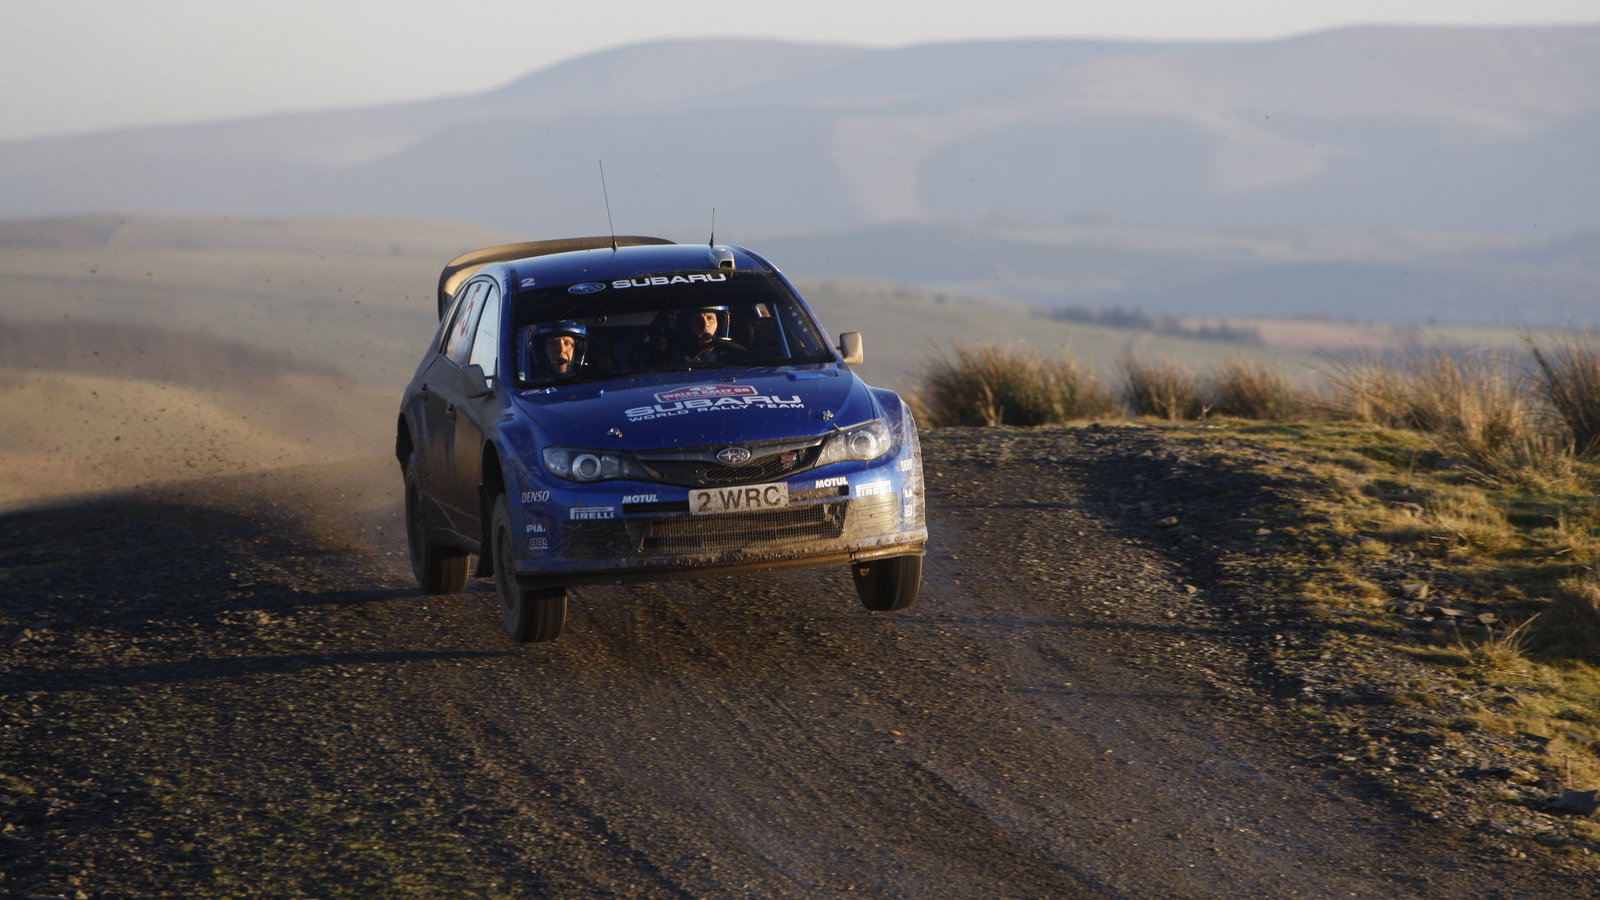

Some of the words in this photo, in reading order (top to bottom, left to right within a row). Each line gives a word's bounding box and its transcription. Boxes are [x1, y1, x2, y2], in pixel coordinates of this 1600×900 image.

[520, 277, 535, 288] 2
[611, 273, 727, 289] SUBARU
[701, 387, 732, 395] RALLY
[624, 395, 802, 418] SUBARU
[629, 409, 689, 422] WORLD
[697, 404, 748, 412] RALLY
[815, 476, 848, 489] MOTUL
[521, 490, 550, 504] DENSO
[622, 494, 658, 504] MOTUL
[697, 491, 712, 513] 2
[719, 485, 781, 511] WRC
[569, 506, 615, 520] PIRELLI
